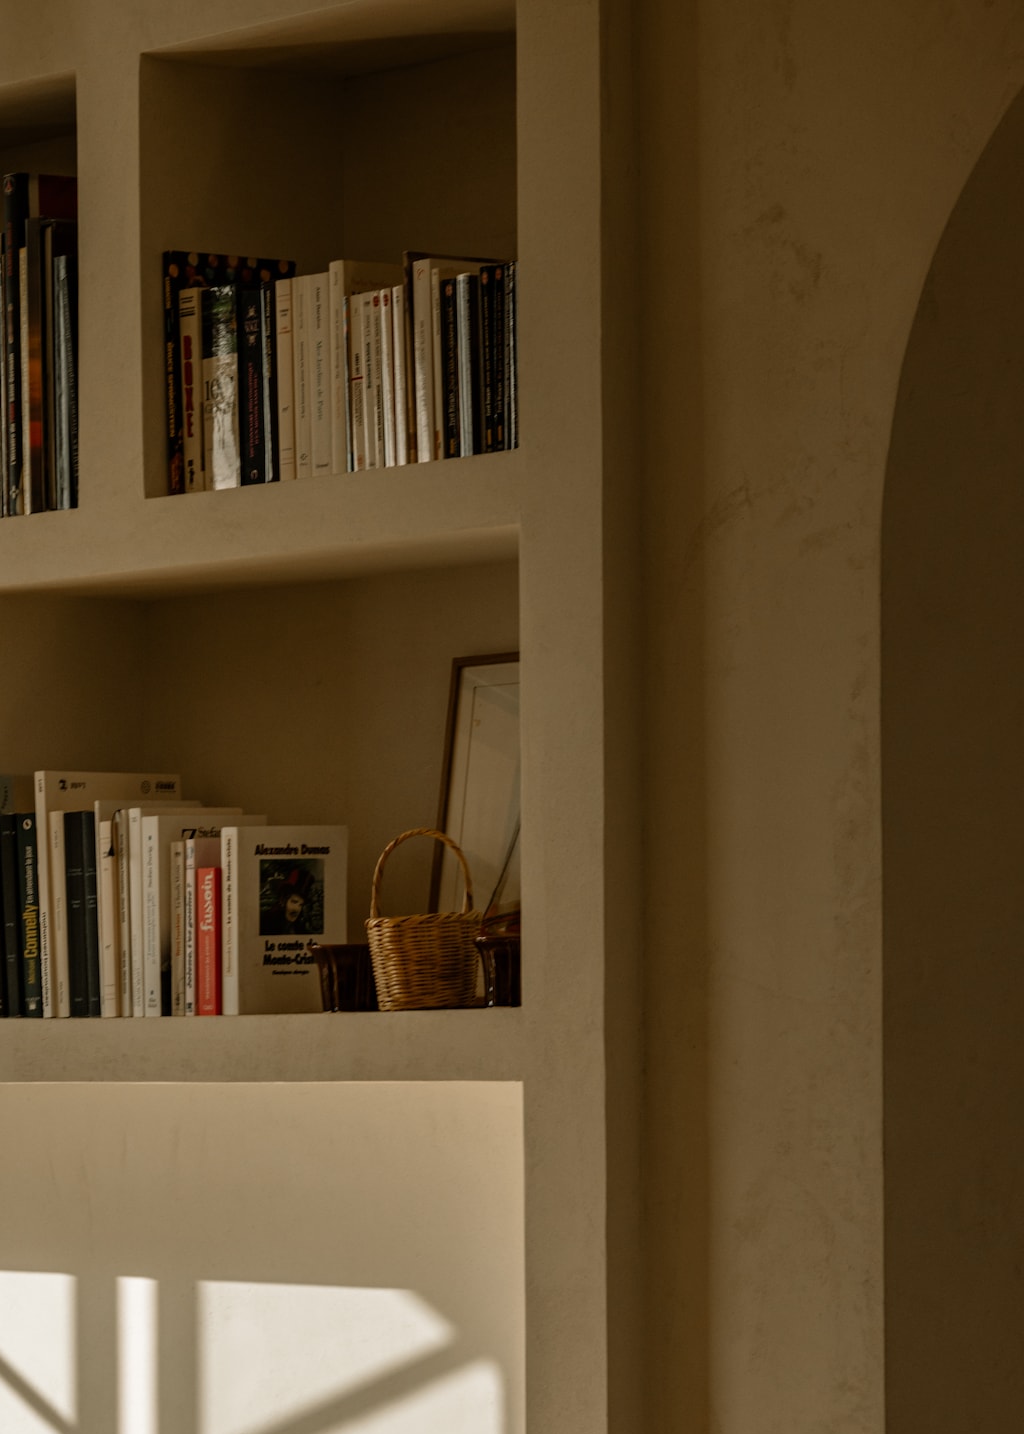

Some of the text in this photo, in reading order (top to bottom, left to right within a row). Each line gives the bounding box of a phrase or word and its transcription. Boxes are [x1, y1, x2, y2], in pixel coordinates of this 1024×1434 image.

[168, 374, 176, 438] SPRINGSTEEN
[254, 843, 331, 856] Alexandre Dumas
[22, 903, 38, 958] Connelly
[265, 940, 275, 951] Le
[278, 940, 304, 951] comte
